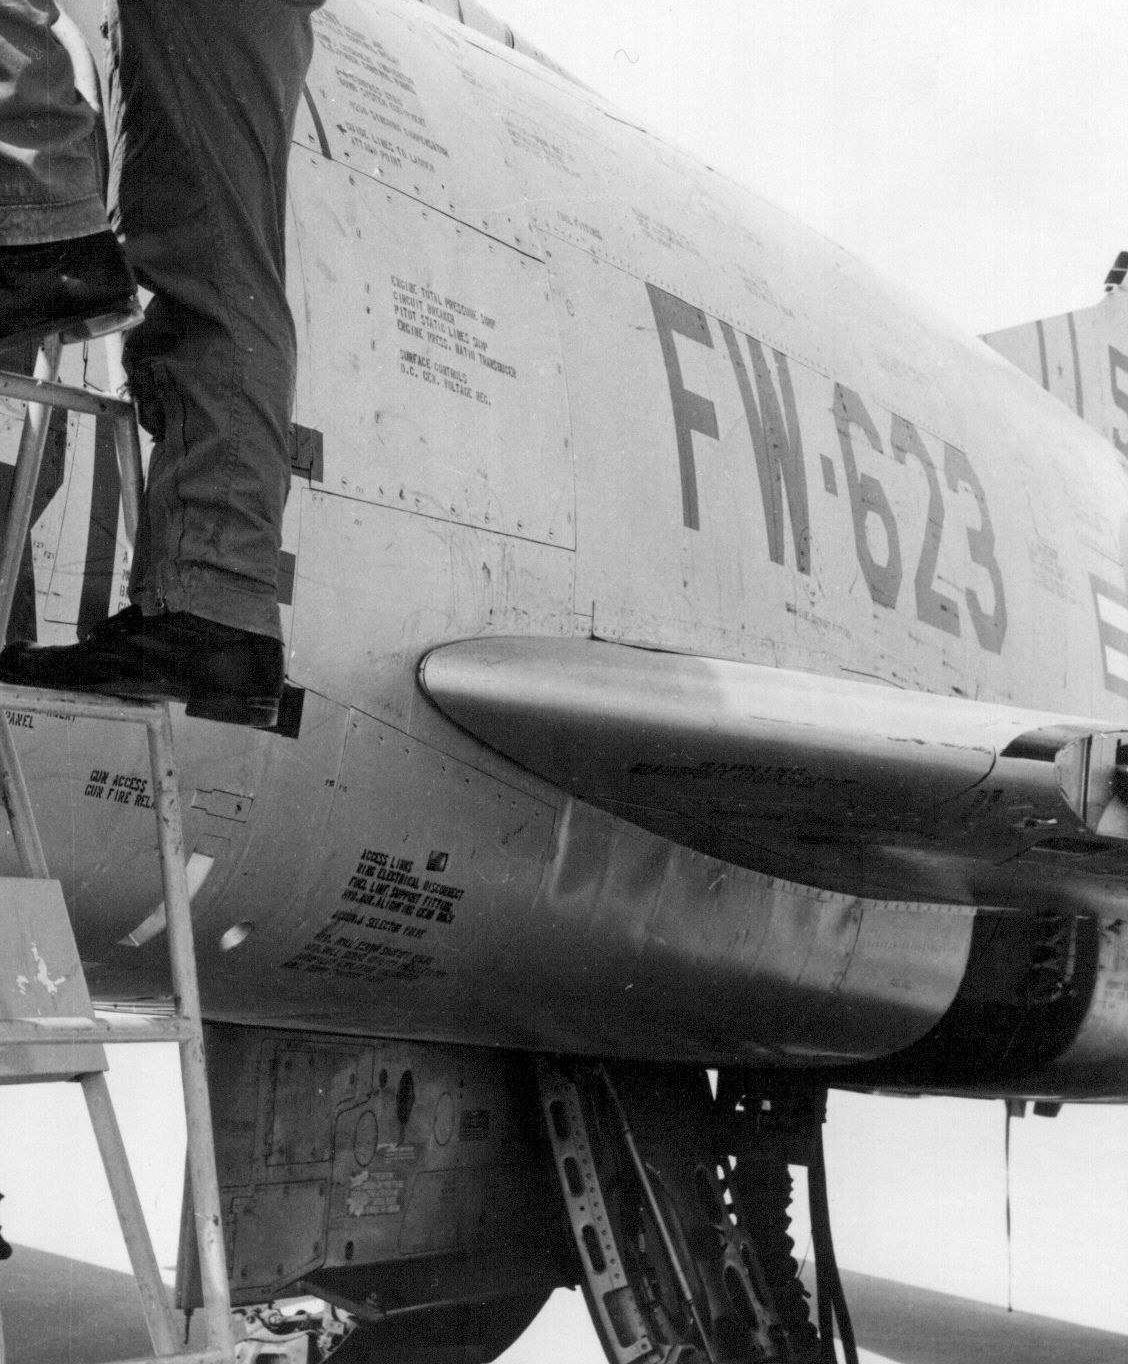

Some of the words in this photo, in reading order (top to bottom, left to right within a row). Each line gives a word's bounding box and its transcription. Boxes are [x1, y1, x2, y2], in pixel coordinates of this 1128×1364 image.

[390, 274, 418, 296] ENGINE
[421, 287, 443, 306] TOTAL
[443, 296, 479, 322] PRESSURE
[392, 290, 423, 310] CIRCUIT
[426, 303, 456, 326] BREAKER
[393, 304, 417, 322] PITOT
[420, 314, 446, 334] STATIC
[447, 325, 470, 345] LINES
[472, 335, 489, 352] SUMP
[396, 318, 424, 340] ENGINE
[426, 330, 453, 351] PRESS.
[454, 342, 476, 361] RATIO
[478, 352, 517, 379] TRANSDUCER
[399, 348, 431, 371] SURFACE
[433, 361, 469, 385] CONTROLS
[400, 362, 419, 379] D.C.
[422, 370, 441, 387] GEN.
[443, 378, 473, 400] VOLTAGE
[645, 281, 1009, 656] FW-623
[84, 783, 104, 799] GUN
[106, 787, 132, 805] FIRE
[89, 768, 110, 785] GUN
[111, 773, 148, 794] ACCESS
[360, 848, 390, 867] ACCESS
[376, 867, 421, 890] ELECTRICAL
[422, 879, 466, 901] DISCONNECT
[388, 885, 423, 905] SUPPORT
